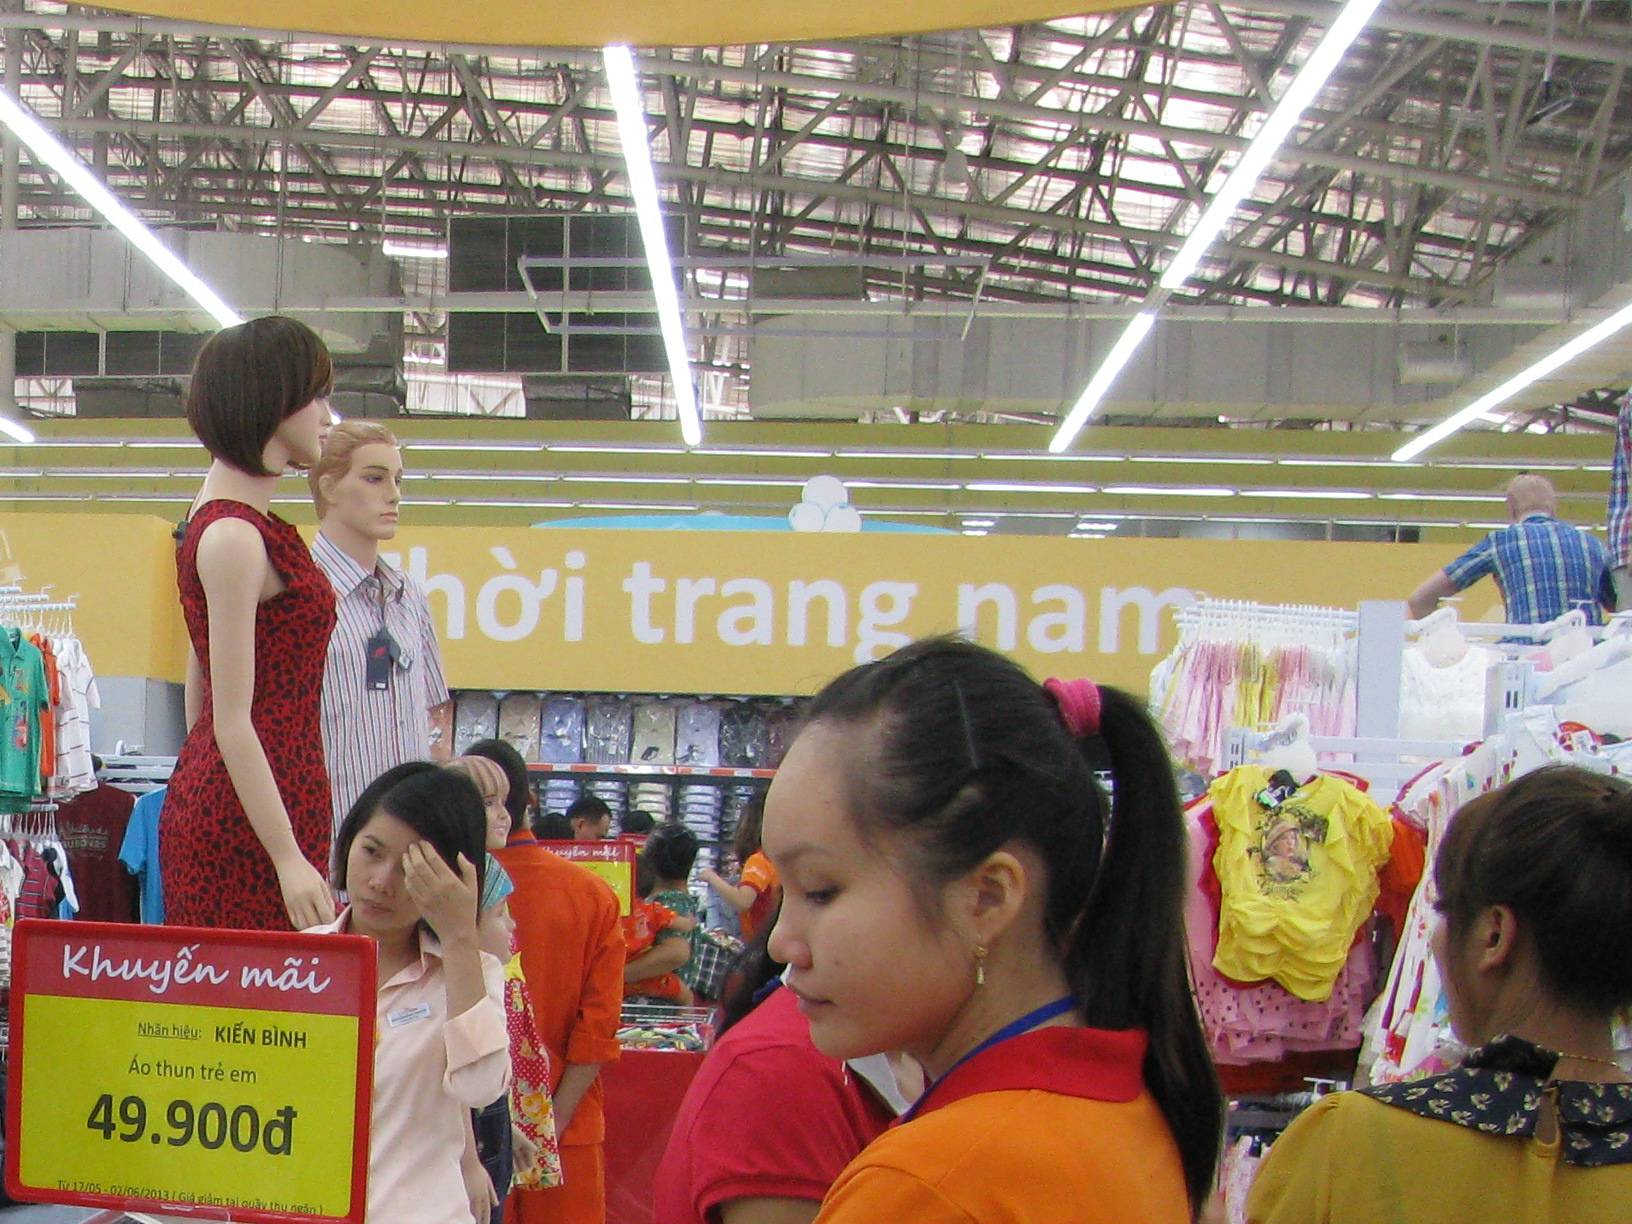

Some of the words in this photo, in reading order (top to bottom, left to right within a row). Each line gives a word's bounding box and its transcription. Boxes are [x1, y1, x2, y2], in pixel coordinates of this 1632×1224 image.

[378, 547, 584, 642] hời
[621, 560, 918, 665] trang
[959, 581, 1193, 654] nam
[62, 943, 229, 994] Khuyến
[240, 957, 331, 994] mãi
[137, 1022, 169, 1037] Nhãn
[172, 1024, 202, 1040] hiệu:
[215, 1021, 256, 1045] KIẾN
[261, 1025, 307, 1048] BÌNH
[128, 1053, 151, 1076] Áo
[156, 1059, 195, 1079] thun
[201, 1061, 224, 1081] trẻ
[230, 1069, 257, 1083] em
[85, 1092, 298, 1156] 49.900đ
[72, 1181, 101, 1194] 17/05
[110, 1185, 169, 1200] 02/06/2013
